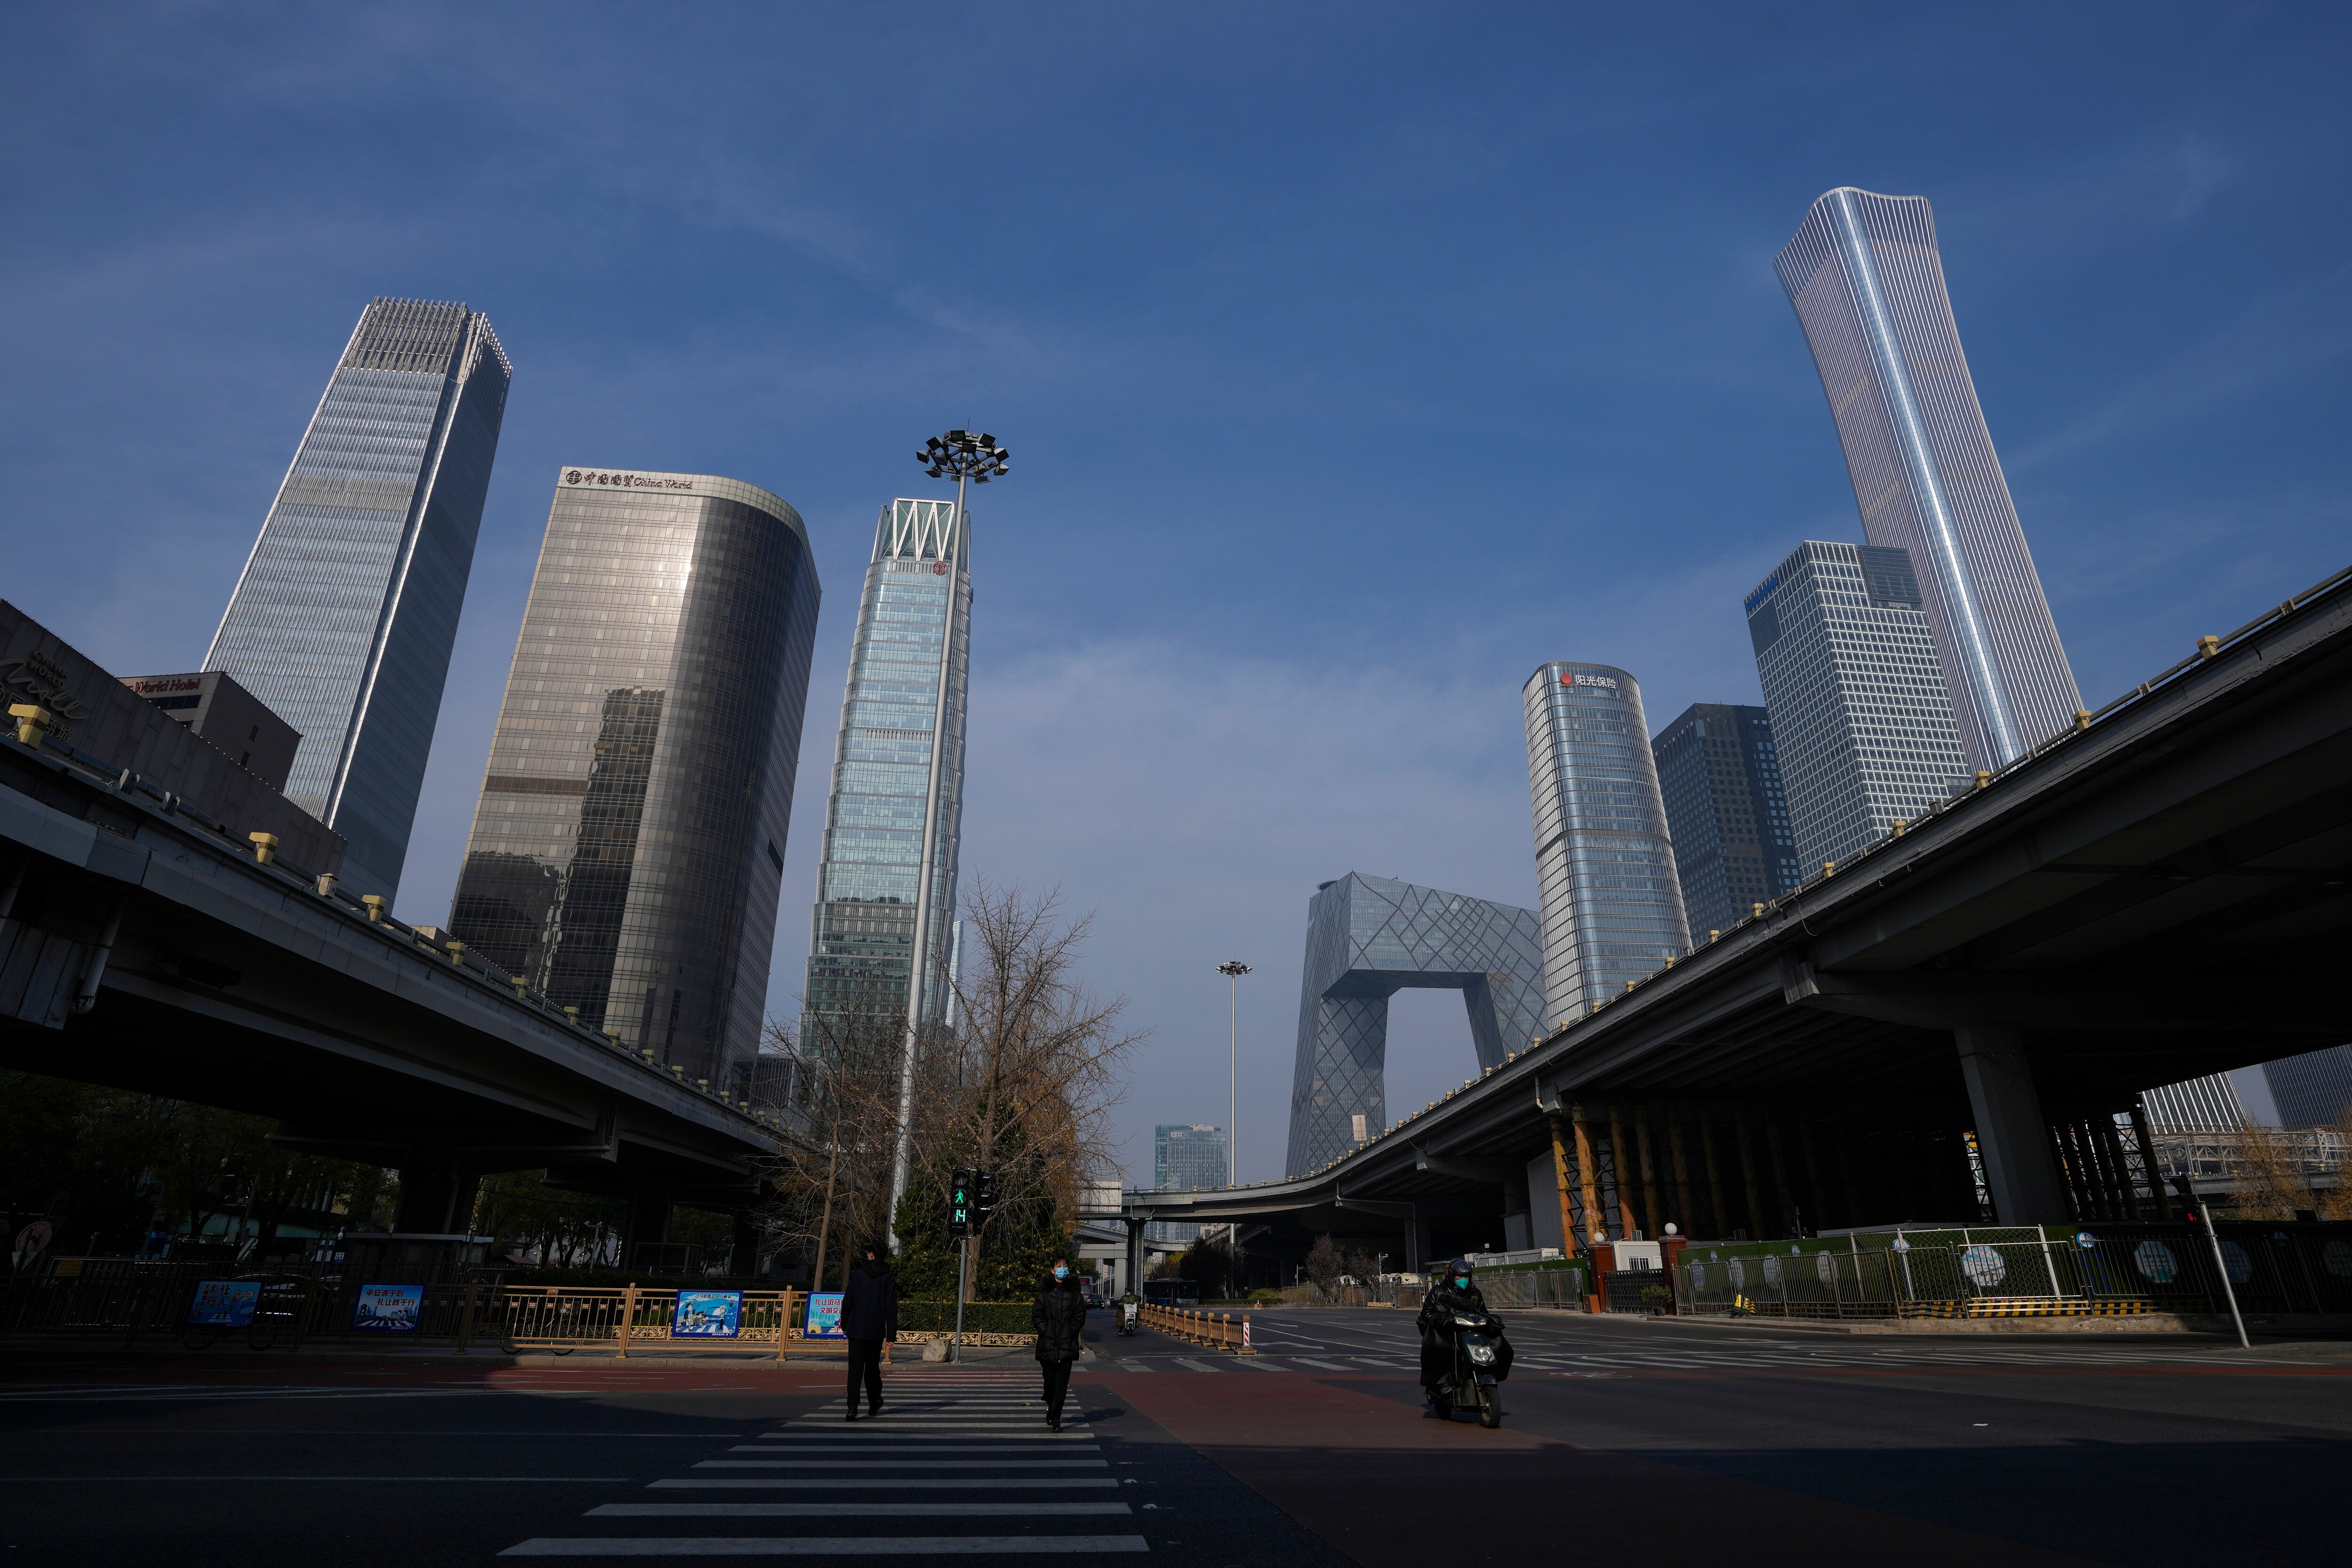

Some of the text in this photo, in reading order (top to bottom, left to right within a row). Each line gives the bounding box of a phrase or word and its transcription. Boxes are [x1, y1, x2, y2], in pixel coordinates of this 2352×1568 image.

[634, 477, 692, 489] China World
[1746, 576, 1778, 611] SAMSUNG
[33, 651, 68, 678] CHINA
[29, 660, 65, 688] WORLD
[135, 678, 201, 693] World Hotel
[1575, 675, 1617, 689] 阳光保险
[955, 1209, 966, 1222] 14
[207, 1296, 226, 1306] 行人
